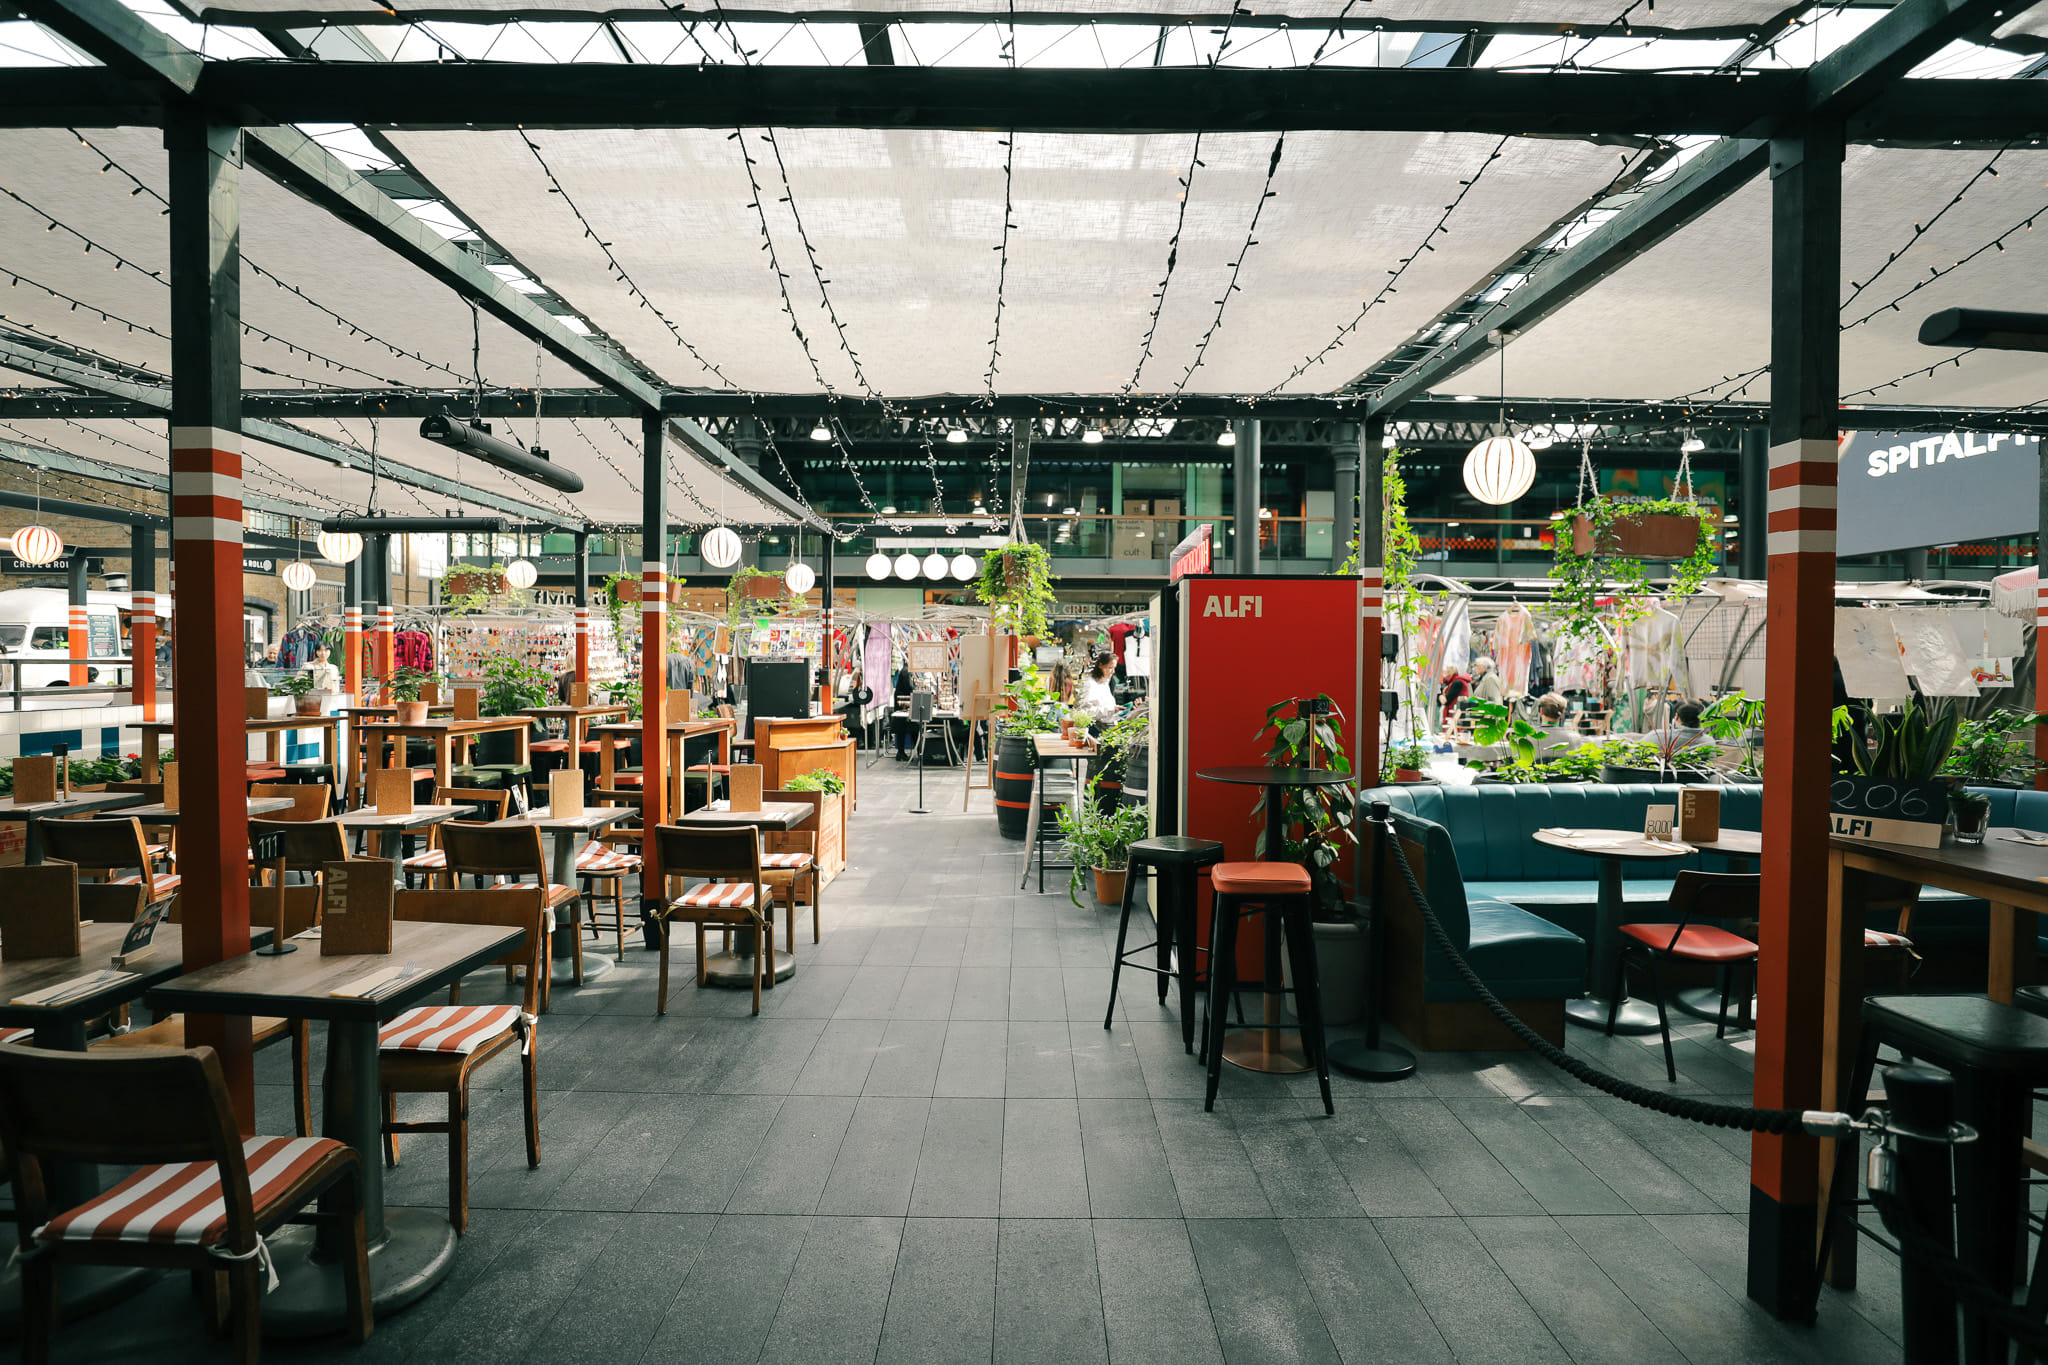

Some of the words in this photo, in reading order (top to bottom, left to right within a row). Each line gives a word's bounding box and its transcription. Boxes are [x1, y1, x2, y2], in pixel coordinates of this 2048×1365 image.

[1203, 595, 1263, 618] ALFI
[1684, 792, 1697, 819] ALFI
[1830, 779, 1929, 817] 206
[258, 834, 278, 860] 111
[327, 867, 348, 914] ALFI
